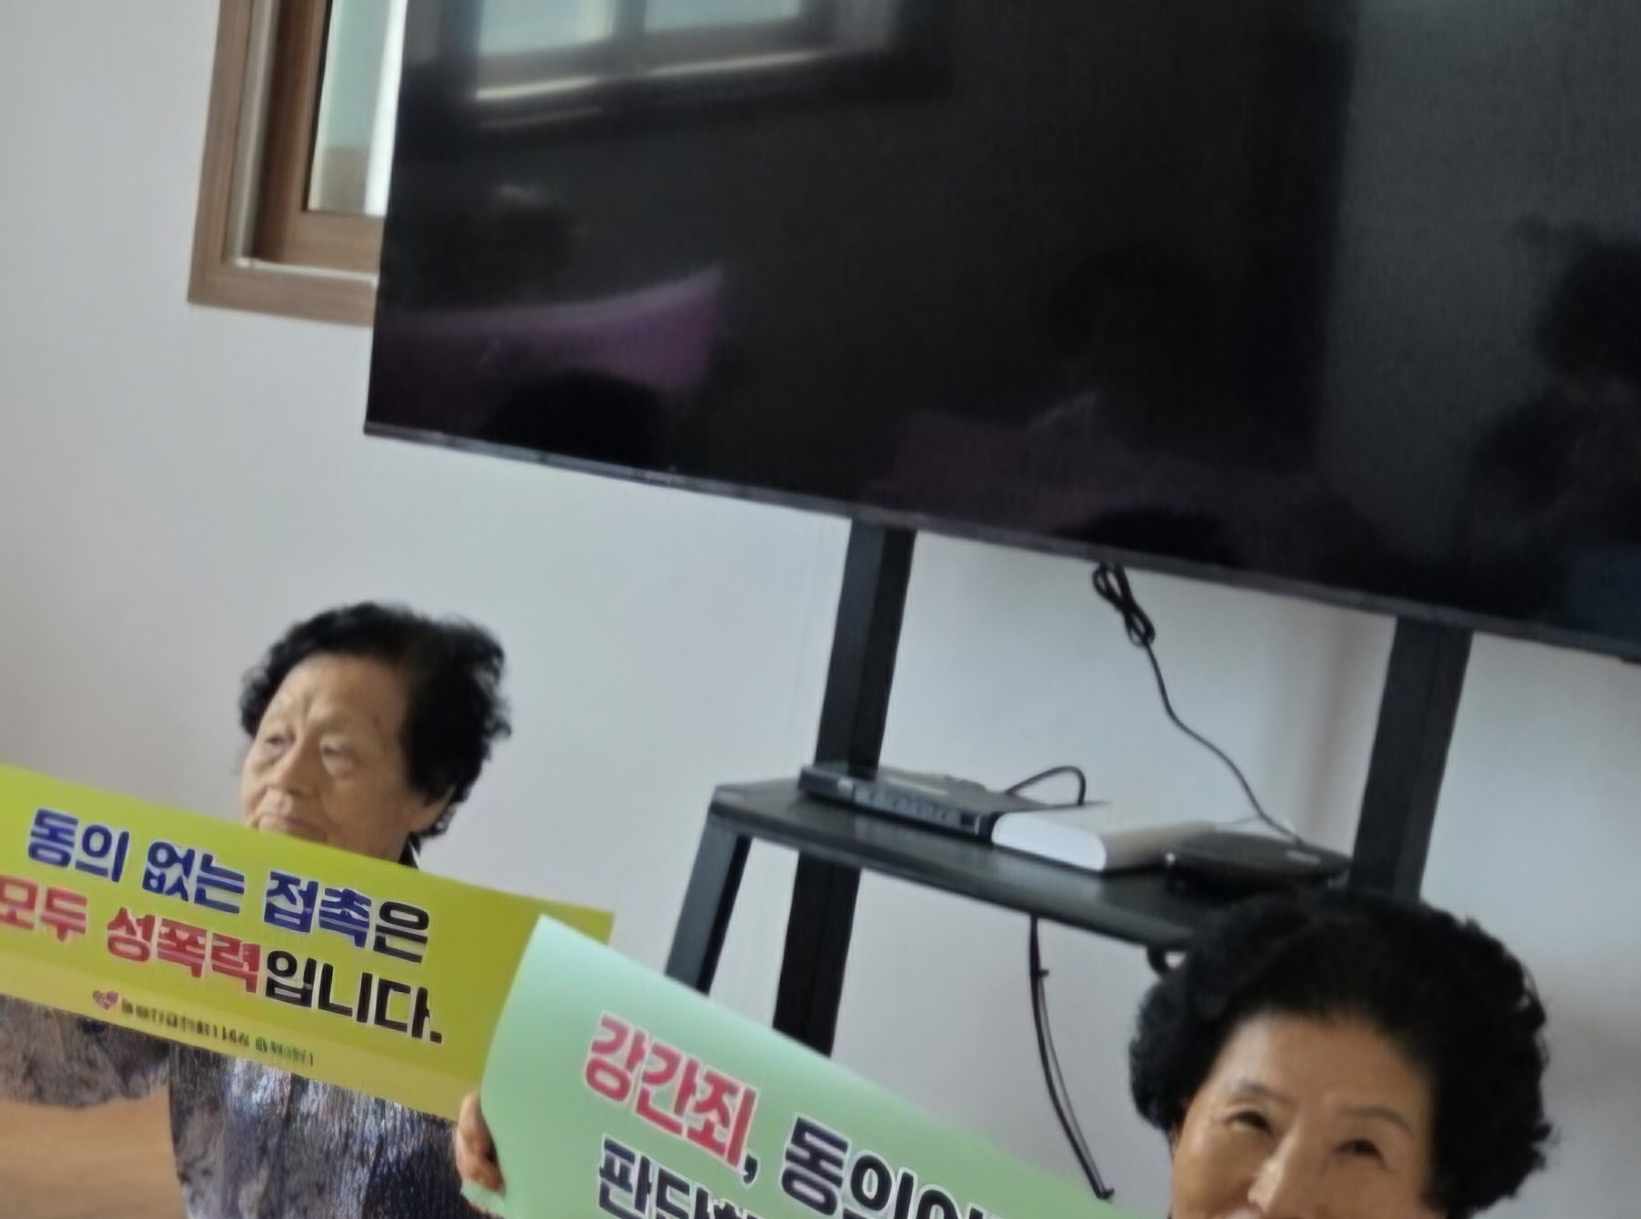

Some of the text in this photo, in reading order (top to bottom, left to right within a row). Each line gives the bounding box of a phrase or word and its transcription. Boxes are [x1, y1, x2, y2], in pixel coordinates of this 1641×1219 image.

[26, 807, 431, 964] 동의 없는 접촉은
[105, 906, 446, 1045] 성폭력입니다.
[582, 1012, 760, 1185] 강간죄,
